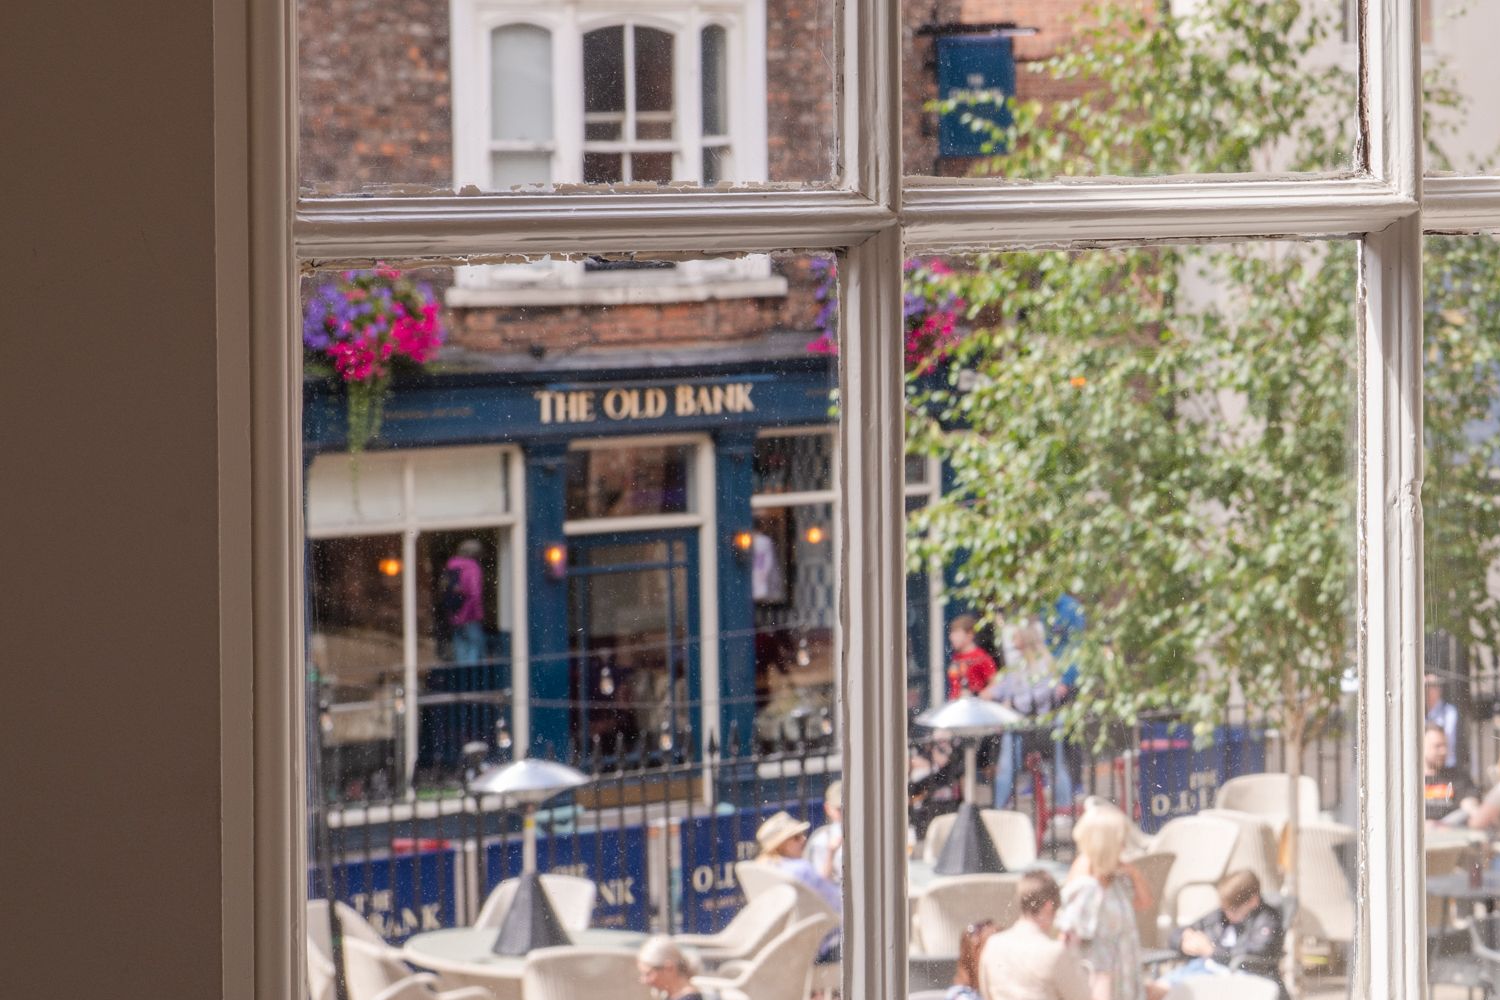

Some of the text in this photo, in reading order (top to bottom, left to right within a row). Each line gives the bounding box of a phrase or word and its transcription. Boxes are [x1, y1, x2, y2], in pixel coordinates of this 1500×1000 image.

[534, 383, 754, 424] THE OLD BANK
